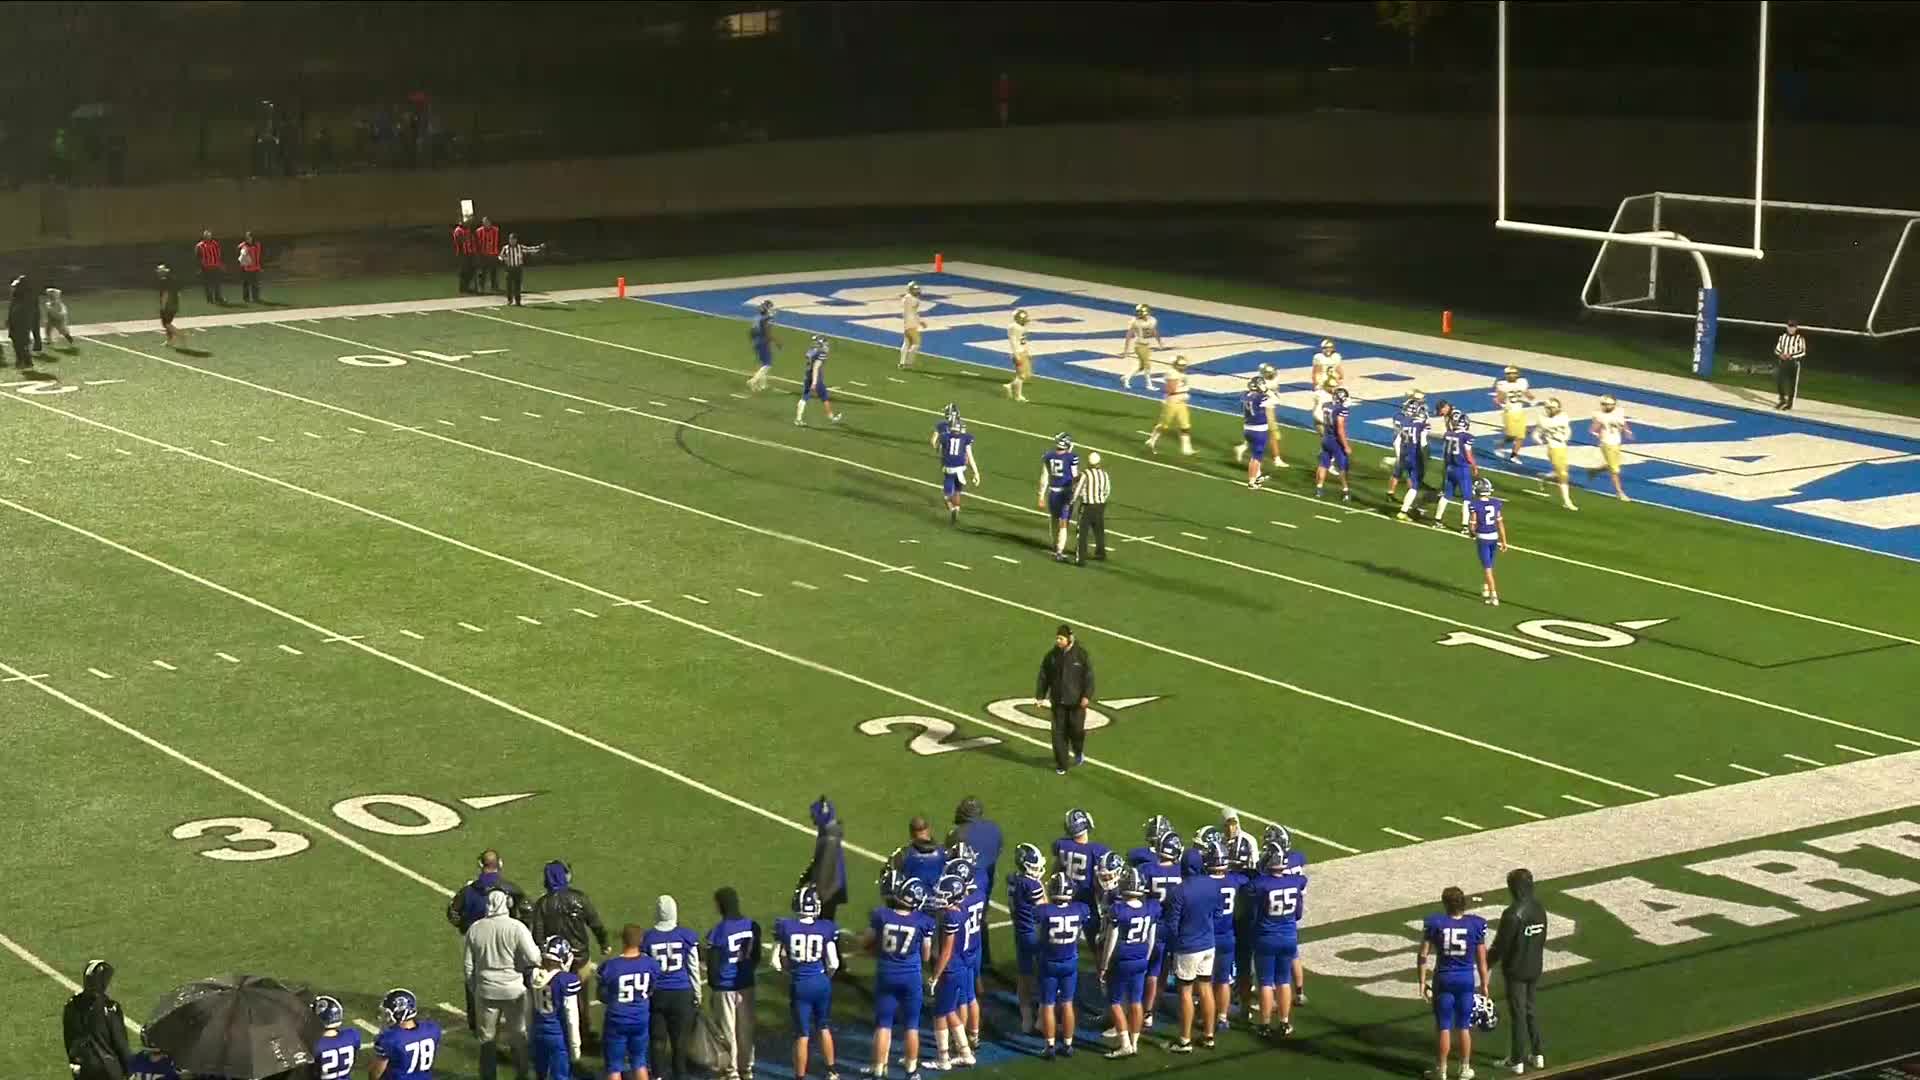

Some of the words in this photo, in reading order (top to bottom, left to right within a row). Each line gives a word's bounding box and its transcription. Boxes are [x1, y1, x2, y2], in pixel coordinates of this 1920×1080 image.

[743, 283, 1920, 531] SPARTA
[949, 437, 961, 456] 11
[1049, 458, 1064, 477] 12
[1484, 505, 1496, 526] 2
[1436, 618, 1637, 661] 10
[858, 697, 1112, 756] 20
[171, 793, 464, 862] 30
[1220, 887, 1236, 915] 3
[1268, 887, 1299, 917] 65
[882, 923, 916, 954] 67
[1048, 915, 1079, 944] 25
[1126, 916, 1151, 944] 21
[1442, 928, 1467, 956] 15
[618, 972, 650, 1003] 54
[320, 1045, 355, 1080] 23
[404, 1038, 436, 1072] 78
